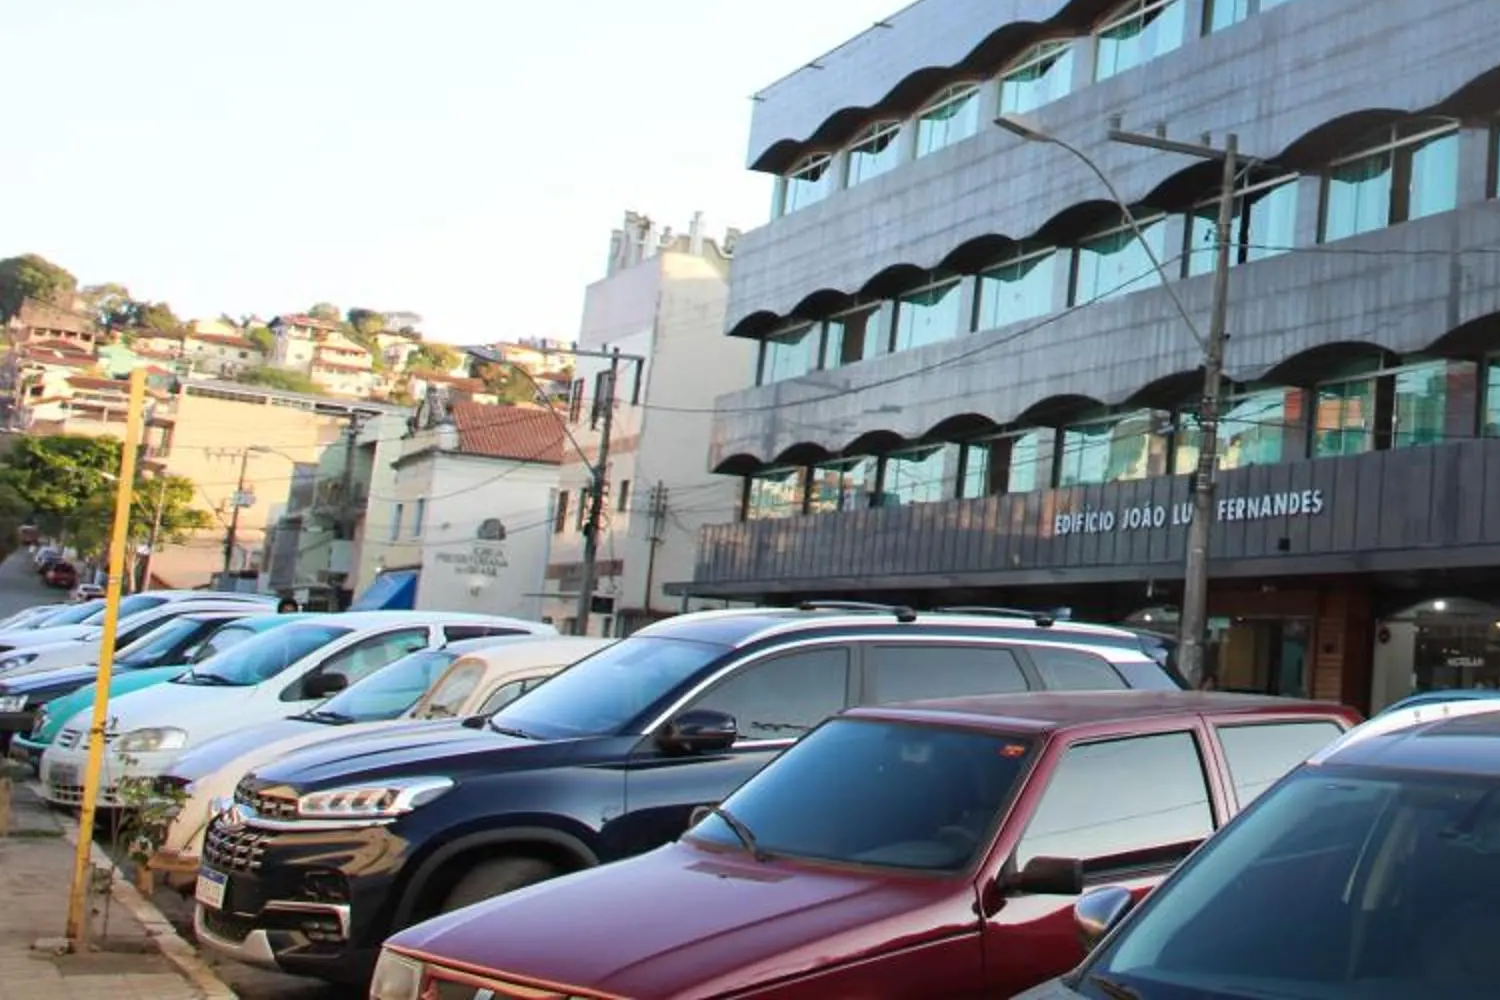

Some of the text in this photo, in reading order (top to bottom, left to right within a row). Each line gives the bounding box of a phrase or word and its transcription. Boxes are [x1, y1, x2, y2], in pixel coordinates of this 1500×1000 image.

[1054, 505, 1114, 536] EDIFÍCIO
[1121, 501, 1165, 530] JOÃO
[1217, 489, 1324, 522] FERNANDES
